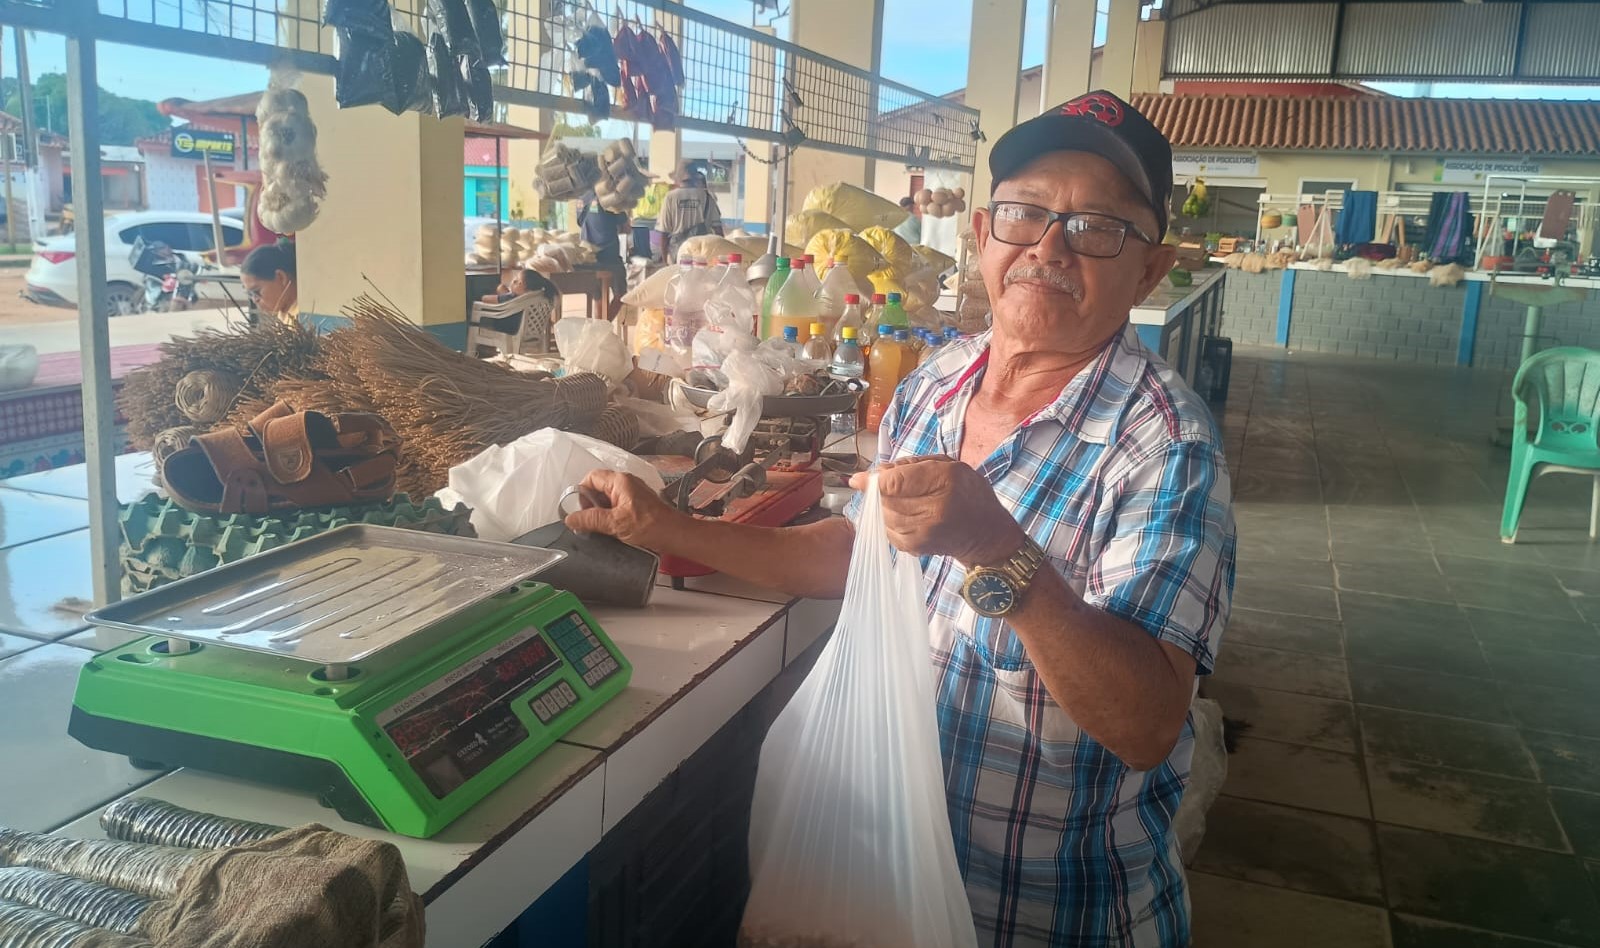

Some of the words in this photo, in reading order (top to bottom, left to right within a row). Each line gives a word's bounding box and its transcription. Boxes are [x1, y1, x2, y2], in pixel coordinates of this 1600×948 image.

[1208, 155, 1215, 163] DE
[1446, 161, 1482, 171] ASSOCIAÇÃO
[1484, 163, 1493, 171] DE
